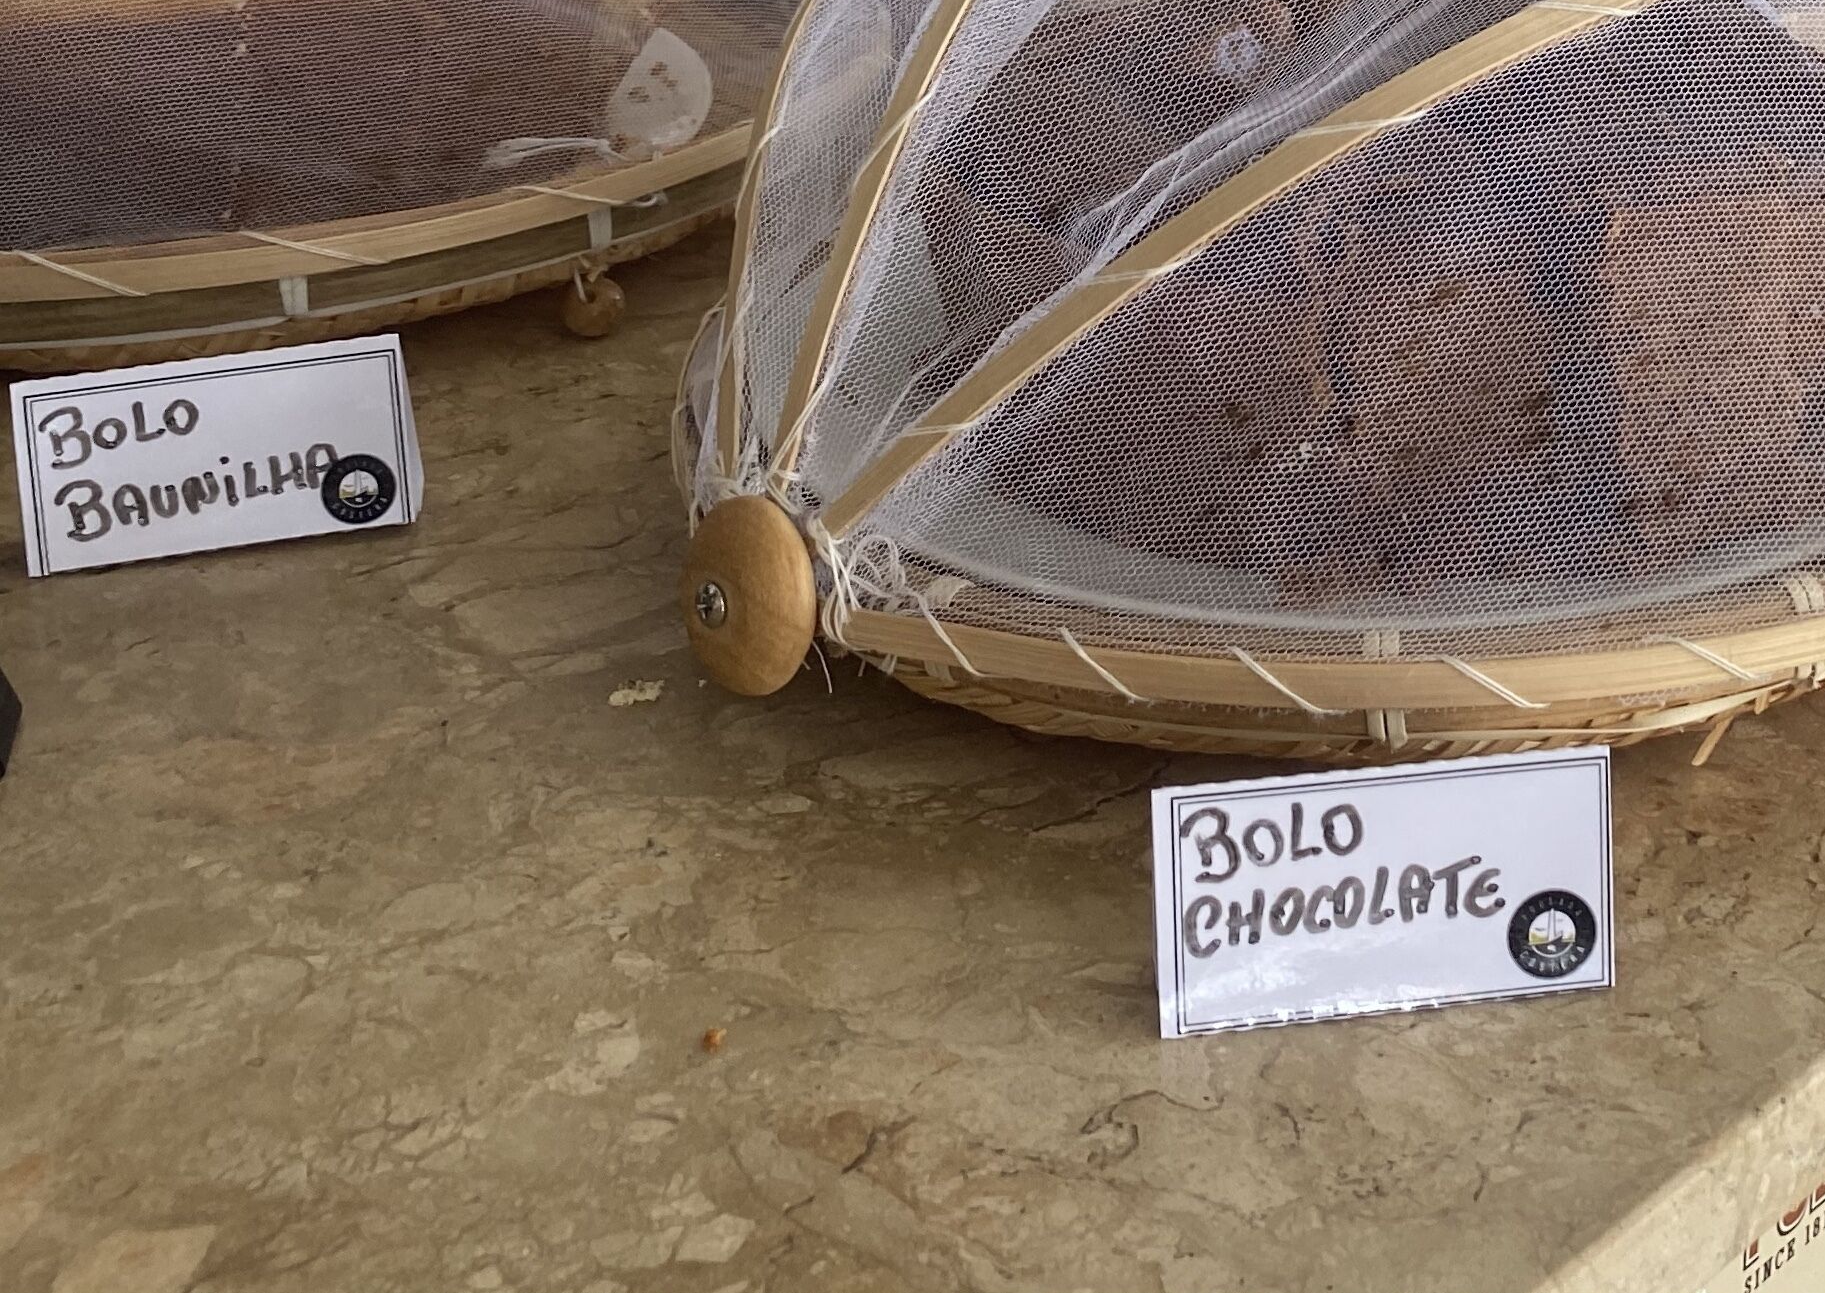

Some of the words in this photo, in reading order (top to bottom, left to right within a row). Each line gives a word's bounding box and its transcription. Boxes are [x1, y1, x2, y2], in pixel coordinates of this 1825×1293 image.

[1180, 802, 1363, 883] BOLO
[1183, 855, 1507, 958] CHOCOLATE
[1743, 1237, 1797, 1293] SINCE
